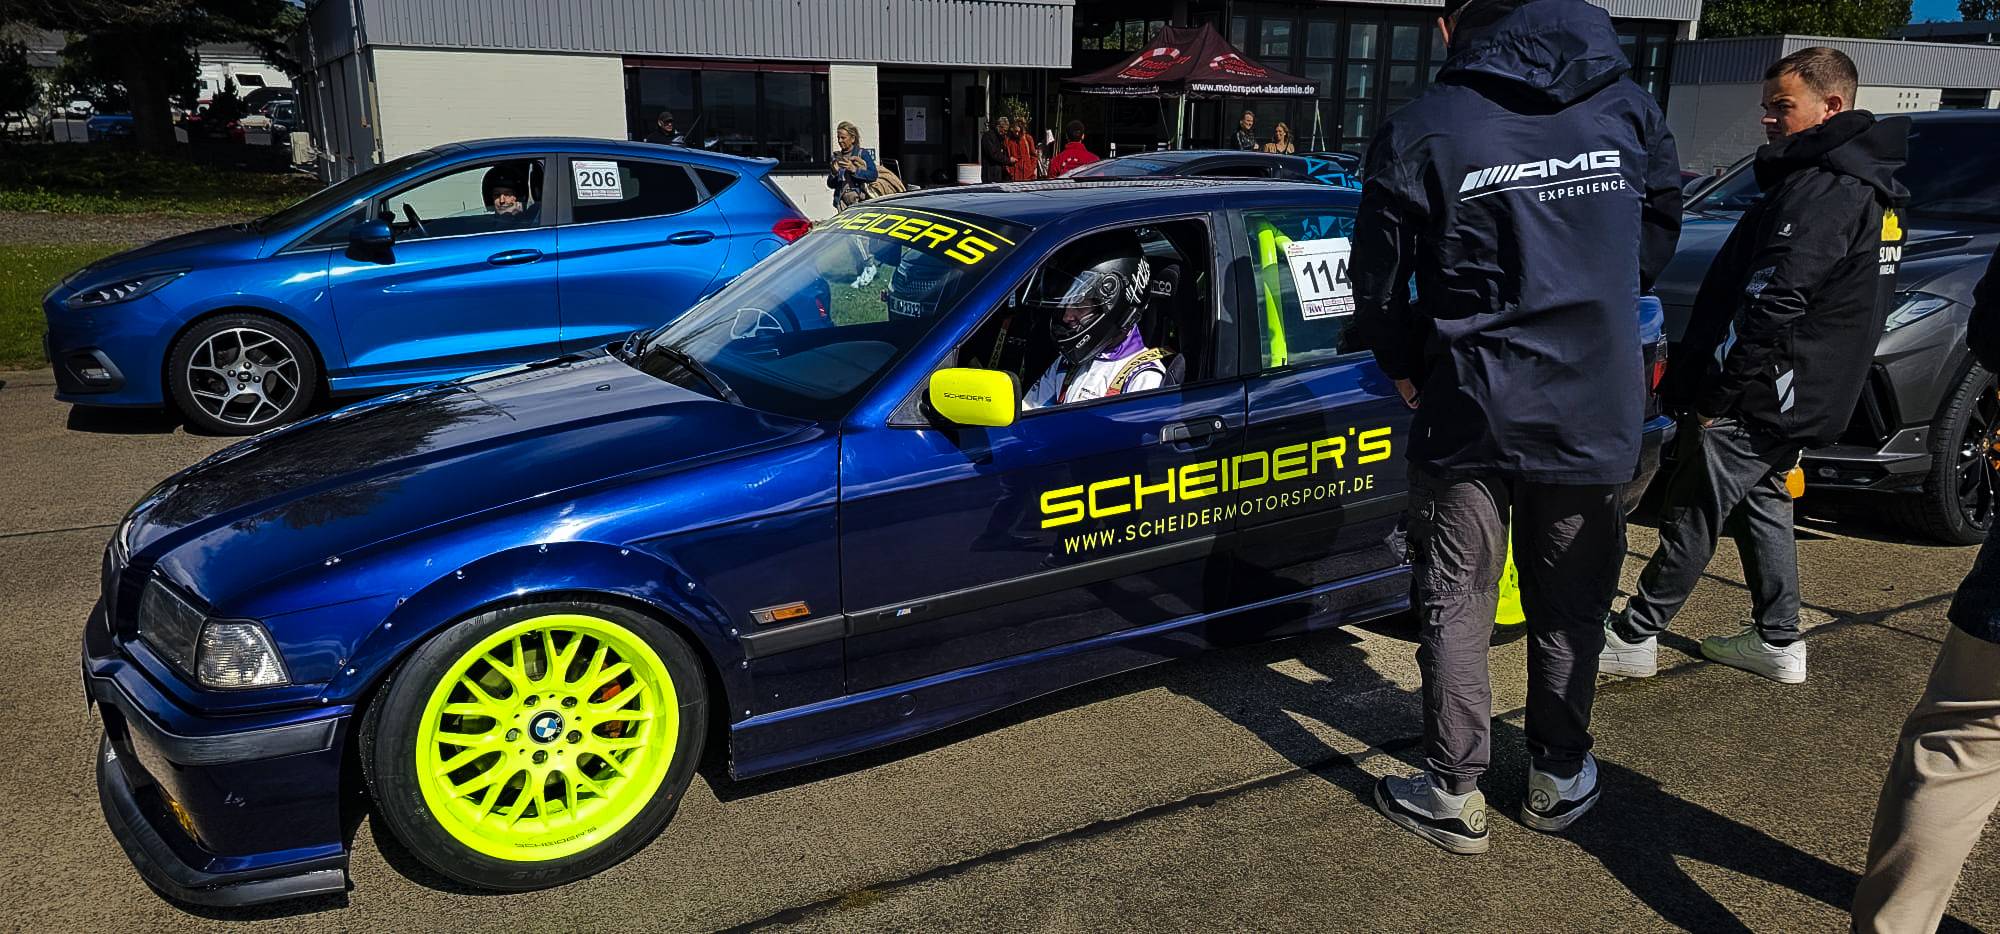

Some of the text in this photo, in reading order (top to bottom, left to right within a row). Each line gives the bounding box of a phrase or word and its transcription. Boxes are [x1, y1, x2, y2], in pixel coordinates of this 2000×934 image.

[1191, 83, 1315, 96] www.motorsport-akademie.de
[1510, 150, 1621, 181] AMG
[579, 171, 616, 187] 206
[1538, 179, 1626, 202] EXPERIENCE
[1302, 258, 1352, 293] 114
[943, 392, 992, 403] SCHEIDER'S
[1039, 426, 1392, 529] SCHEIDER'S
[1064, 474, 1375, 555] WWW.SCHEIDERMOTORSPORT.DE
[514, 825, 598, 848] SCHEIDER'S
